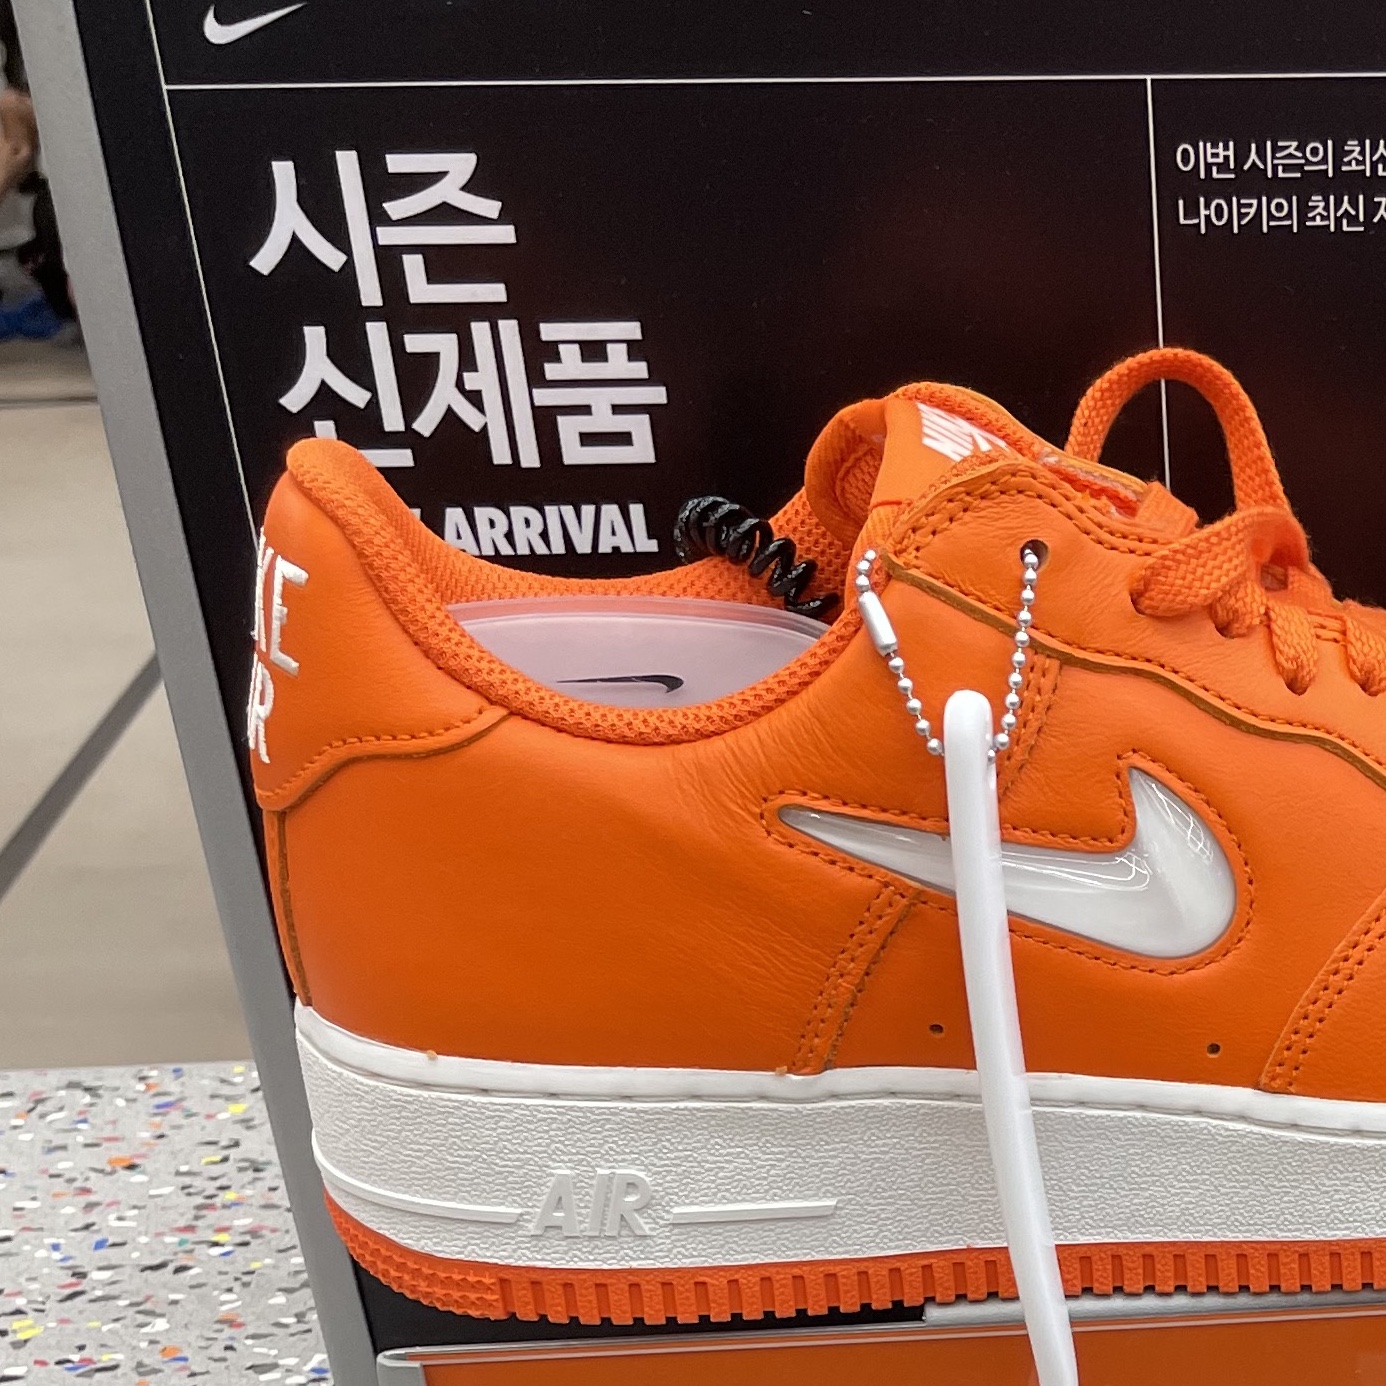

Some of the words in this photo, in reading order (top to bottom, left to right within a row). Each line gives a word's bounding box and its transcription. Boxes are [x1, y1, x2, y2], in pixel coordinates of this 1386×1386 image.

[1175, 140, 1237, 180] 이번
[1242, 138, 1335, 180] 시즌의
[249, 150, 516, 307] 시즌
[1177, 194, 1299, 235] 나이키의
[1304, 193, 1366, 233] 최신
[278, 319, 668, 469] 신제품
[444, 503, 660, 556] ARRIVAL
[530, 1166, 653, 1237] AIR
